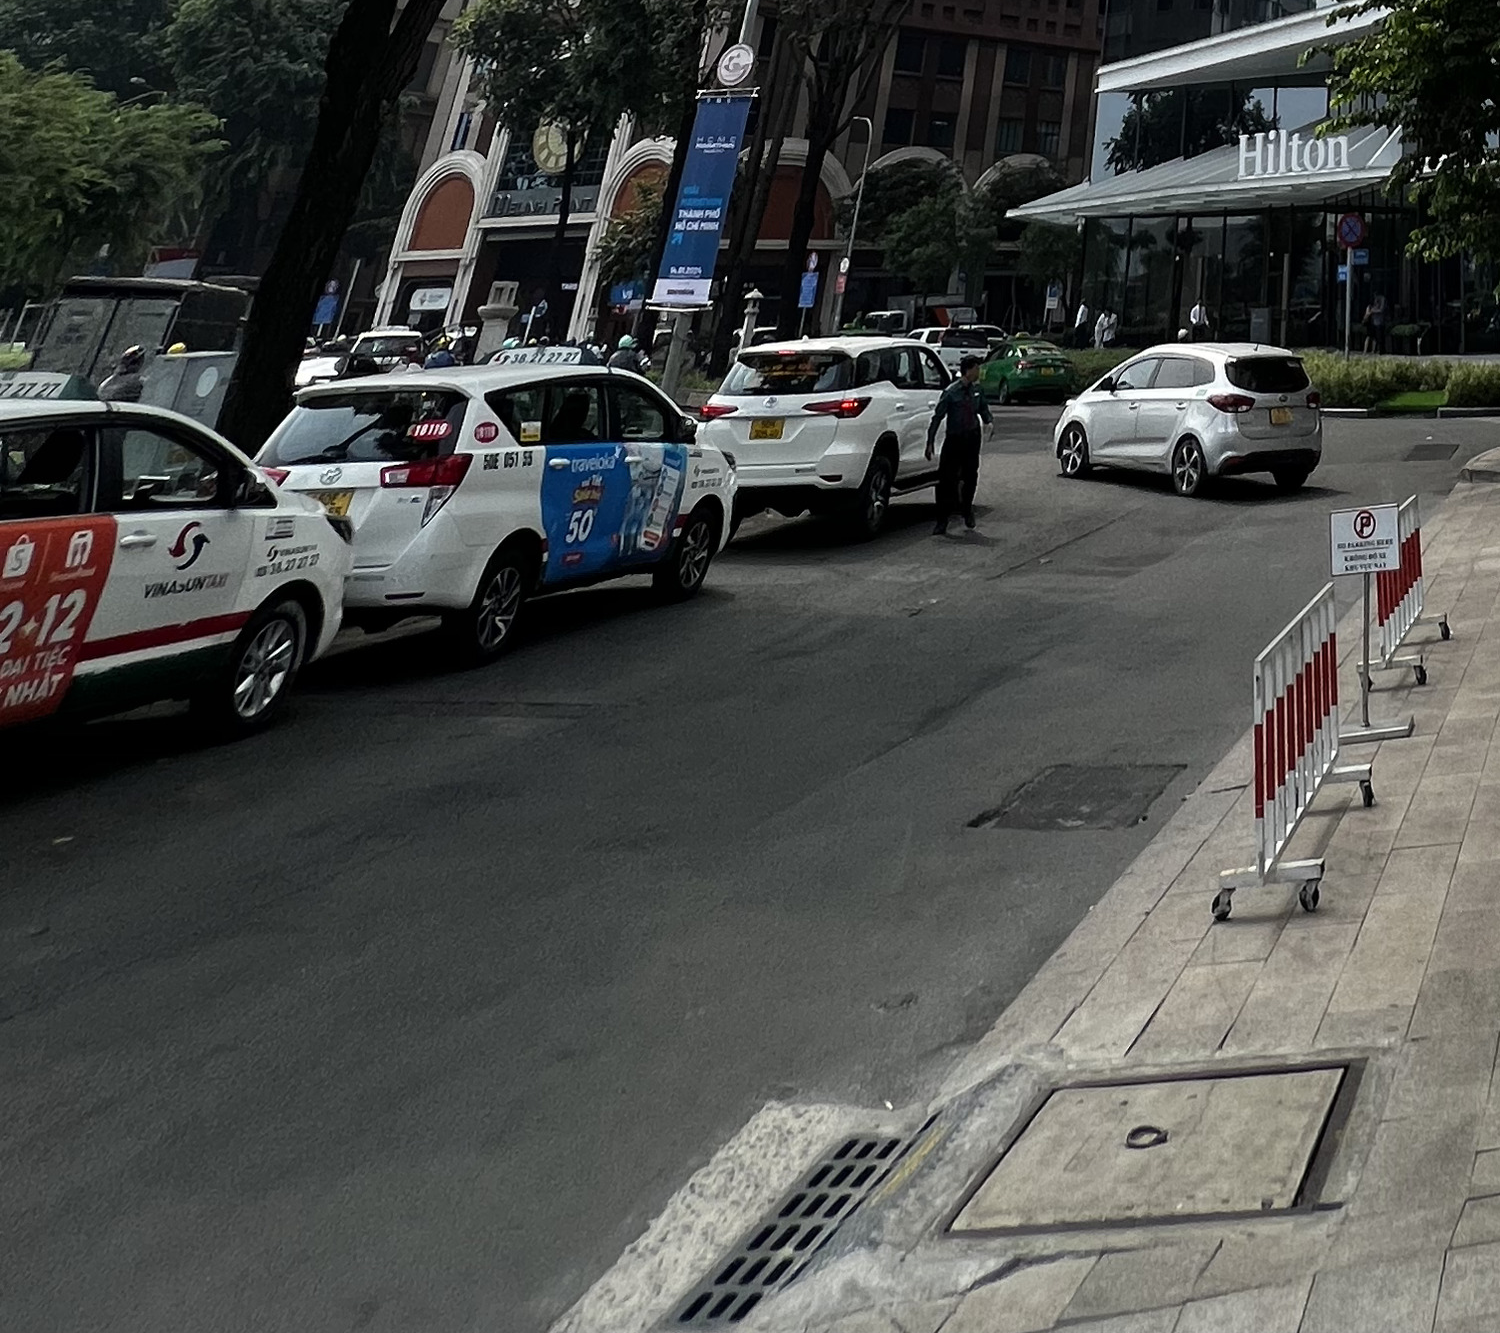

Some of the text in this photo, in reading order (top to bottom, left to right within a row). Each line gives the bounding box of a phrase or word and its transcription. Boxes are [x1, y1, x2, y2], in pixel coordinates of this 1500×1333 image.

[1238, 129, 1351, 181] Hilton
[34, 382, 61, 398] 27
[565, 508, 594, 544] 50
